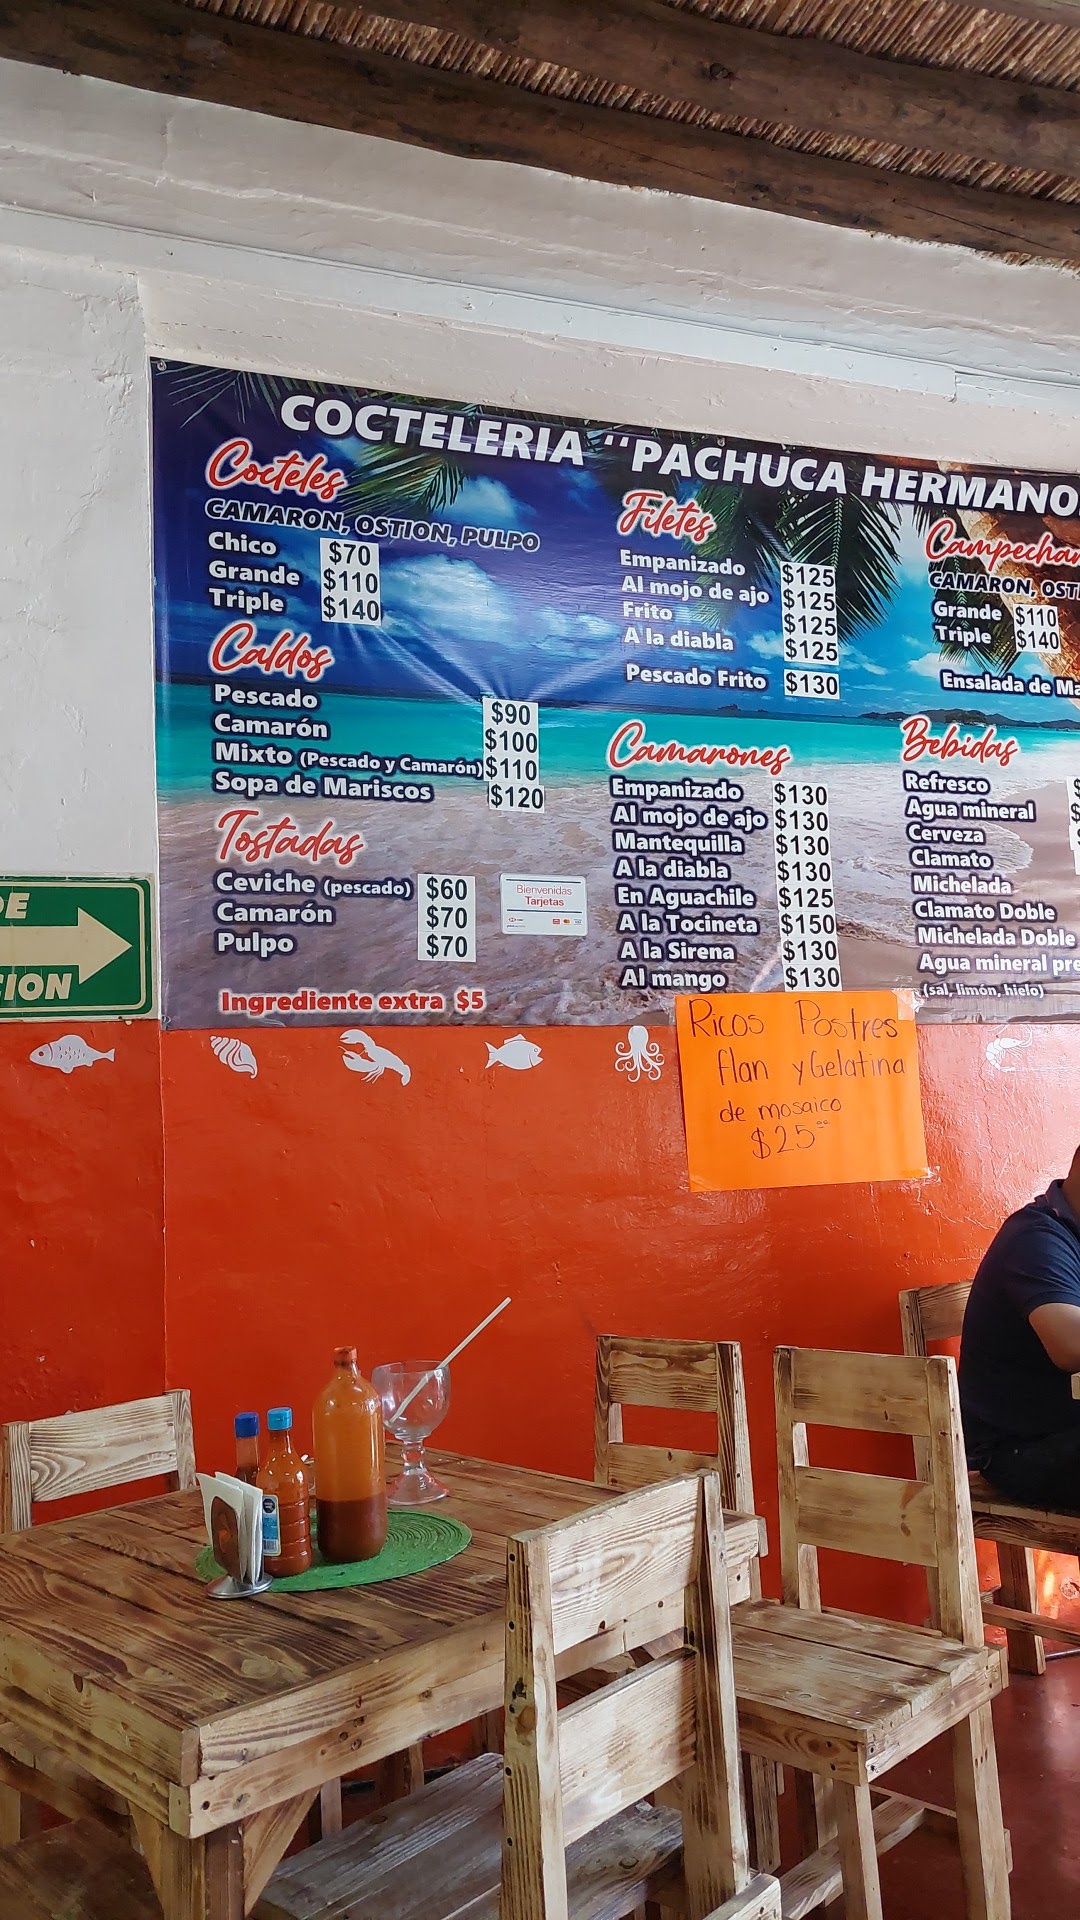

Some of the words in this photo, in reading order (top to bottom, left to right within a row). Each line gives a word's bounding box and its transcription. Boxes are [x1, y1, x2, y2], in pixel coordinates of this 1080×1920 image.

[280, 394, 584, 466] COCTELERIA
[862, 465, 1080, 517] HERMANO
[209, 440, 345, 500] Cocteles
[206, 499, 348, 534] CAMARON,
[356, 516, 456, 545] OSTION,
[463, 528, 540, 552] PULPO
[618, 491, 715, 541] Filetes
[208, 532, 277, 555] Chico
[329, 541, 370, 566] $70
[208, 561, 300, 586] Grande
[620, 549, 746, 576] Empanizado
[323, 568, 378, 594] $110
[782, 564, 835, 588] $125
[929, 573, 1036, 597] CAMARON,
[209, 588, 284, 614] Triple
[621, 576, 644, 592] Al
[650, 580, 703, 601] mojo
[708, 584, 735, 601] de
[739, 587, 770, 606] ajo
[783, 589, 836, 612] $125
[323, 599, 379, 622] $140
[623, 601, 673, 621] Frito
[934, 601, 1002, 621] Grande
[1016, 606, 1056, 627] $110
[784, 615, 837, 637] $125
[935, 626, 992, 647] Triple
[624, 627, 640, 644] A
[645, 627, 665, 645] la
[669, 630, 734, 650] diabla
[1017, 630, 1059, 650] $140
[211, 622, 332, 679] Caldos
[785, 639, 838, 662] $125
[626, 663, 712, 687] Pescado
[718, 668, 767, 690] Frito
[785, 673, 838, 696] $130
[942, 673, 1024, 693] Ensalada
[1029, 678, 1051, 694] de
[214, 684, 318, 709] Pescado
[491, 701, 531, 726] $90
[214, 713, 328, 738] Camarón
[484, 729, 538, 754] $100
[609, 722, 790, 775] Camarones
[903, 717, 1018, 766] Bebidas
[216, 742, 292, 764] Mixto
[300, 751, 381, 771] (Pescado
[384, 760, 394, 774] y
[399, 758, 483, 777] Camarón)
[485, 757, 538, 781] $110
[214, 771, 279, 797] Sopa
[285, 775, 316, 795] de
[324, 777, 432, 800] Mariscos
[612, 779, 741, 801] Empanizado
[774, 782, 827, 805] $130
[906, 773, 988, 792] Refresco
[491, 785, 544, 810] $120
[614, 805, 635, 823] Al
[642, 808, 696, 829] mojo
[703, 809, 728, 825] de
[734, 811, 766, 831] ajo
[775, 808, 828, 831] $130
[906, 800, 958, 820] Agua
[962, 802, 1034, 820] mineral
[218, 809, 364, 865] Tostadas
[615, 833, 742, 856] Mantequilla
[776, 834, 829, 856] $130
[908, 825, 984, 843] Cerveza
[616, 859, 632, 877] A
[638, 860, 657, 877] la
[664, 861, 728, 879] diabla
[911, 850, 992, 868] Clamato
[777, 860, 831, 882] $130
[216, 871, 316, 894] Ceviche
[324, 878, 411, 897] (pescado)
[426, 876, 468, 901] $60
[517, 884, 572, 895] Bienvenidas
[913, 876, 1012, 894] Michelada
[525, 896, 564, 907] Tarjetas
[618, 887, 643, 903] En
[650, 887, 754, 909] Aguachile
[778, 887, 833, 908] $125
[216, 902, 332, 922] Camarón
[426, 906, 468, 931] $70
[915, 901, 994, 919] Clamato
[1000, 904, 1055, 920] Doble
[619, 914, 635, 931] A
[642, 915, 660, 931] la
[666, 916, 757, 933] Tocineta
[781, 914, 835, 936] $150
[218, 932, 294, 957] Pulpo
[426, 934, 468, 959] $70
[918, 927, 1016, 945] Michelada
[1021, 929, 1075, 946] Doble
[620, 941, 637, 958] A
[643, 942, 662, 959] la
[667, 942, 734, 960] Sirena
[783, 940, 837, 962] $130
[920, 954, 970, 975] Agua
[976, 954, 1046, 972] mineral
[621, 969, 644, 986] Al
[652, 972, 725, 990] mango
[785, 967, 839, 989] $130
[222, 991, 372, 1014] Ingrediente
[378, 995, 443, 1009] extra
[457, 990, 484, 1012] $5
[923, 984, 952, 998] (sal,
[956, 984, 1001, 998] limón,
[1004, 984, 1044, 998] hielo)
[689, 998, 764, 1037] Ricos
[795, 1000, 898, 1041] Postres
[793, 1061, 804, 1085] y
[811, 1049, 905, 1078] Gelatina
[720, 1100, 746, 1122] de
[758, 1098, 842, 1120] mosaico
